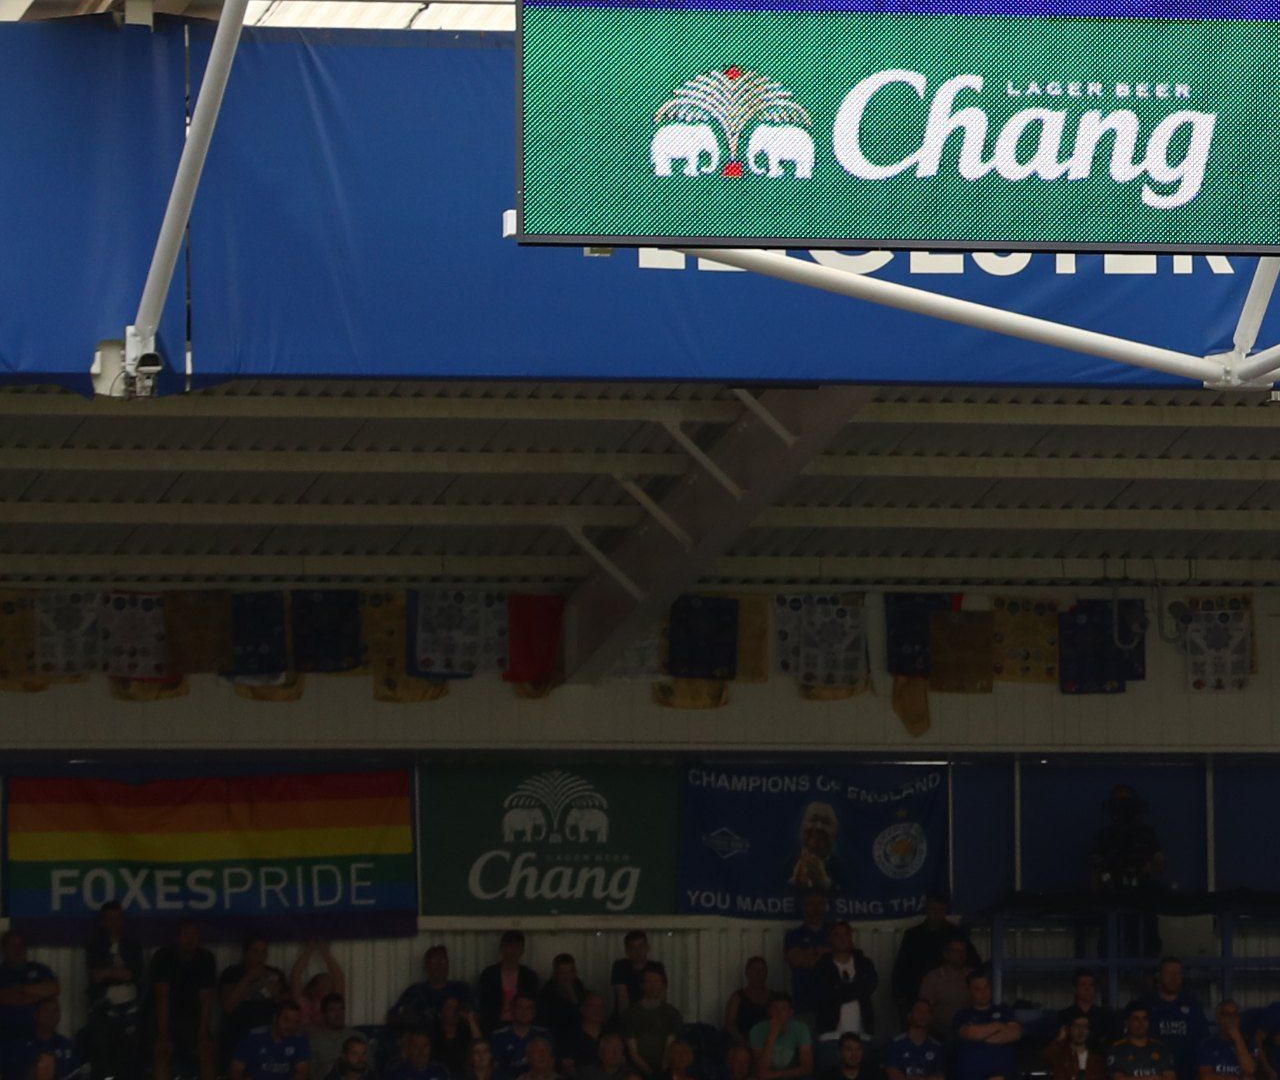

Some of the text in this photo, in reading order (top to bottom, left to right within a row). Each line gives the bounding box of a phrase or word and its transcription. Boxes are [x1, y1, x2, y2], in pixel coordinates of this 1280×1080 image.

[1006, 81, 1192, 100] LAGER BEER
[832, 68, 1217, 210] Chang
[687, 769, 810, 793] CHAMPIONS
[847, 772, 942, 803] ENGLAND
[50, 863, 376, 911] FOXESPRIDE
[467, 850, 642, 912] Chang
[687, 890, 795, 914] YOU MADE
[836, 897, 884, 915] SING
